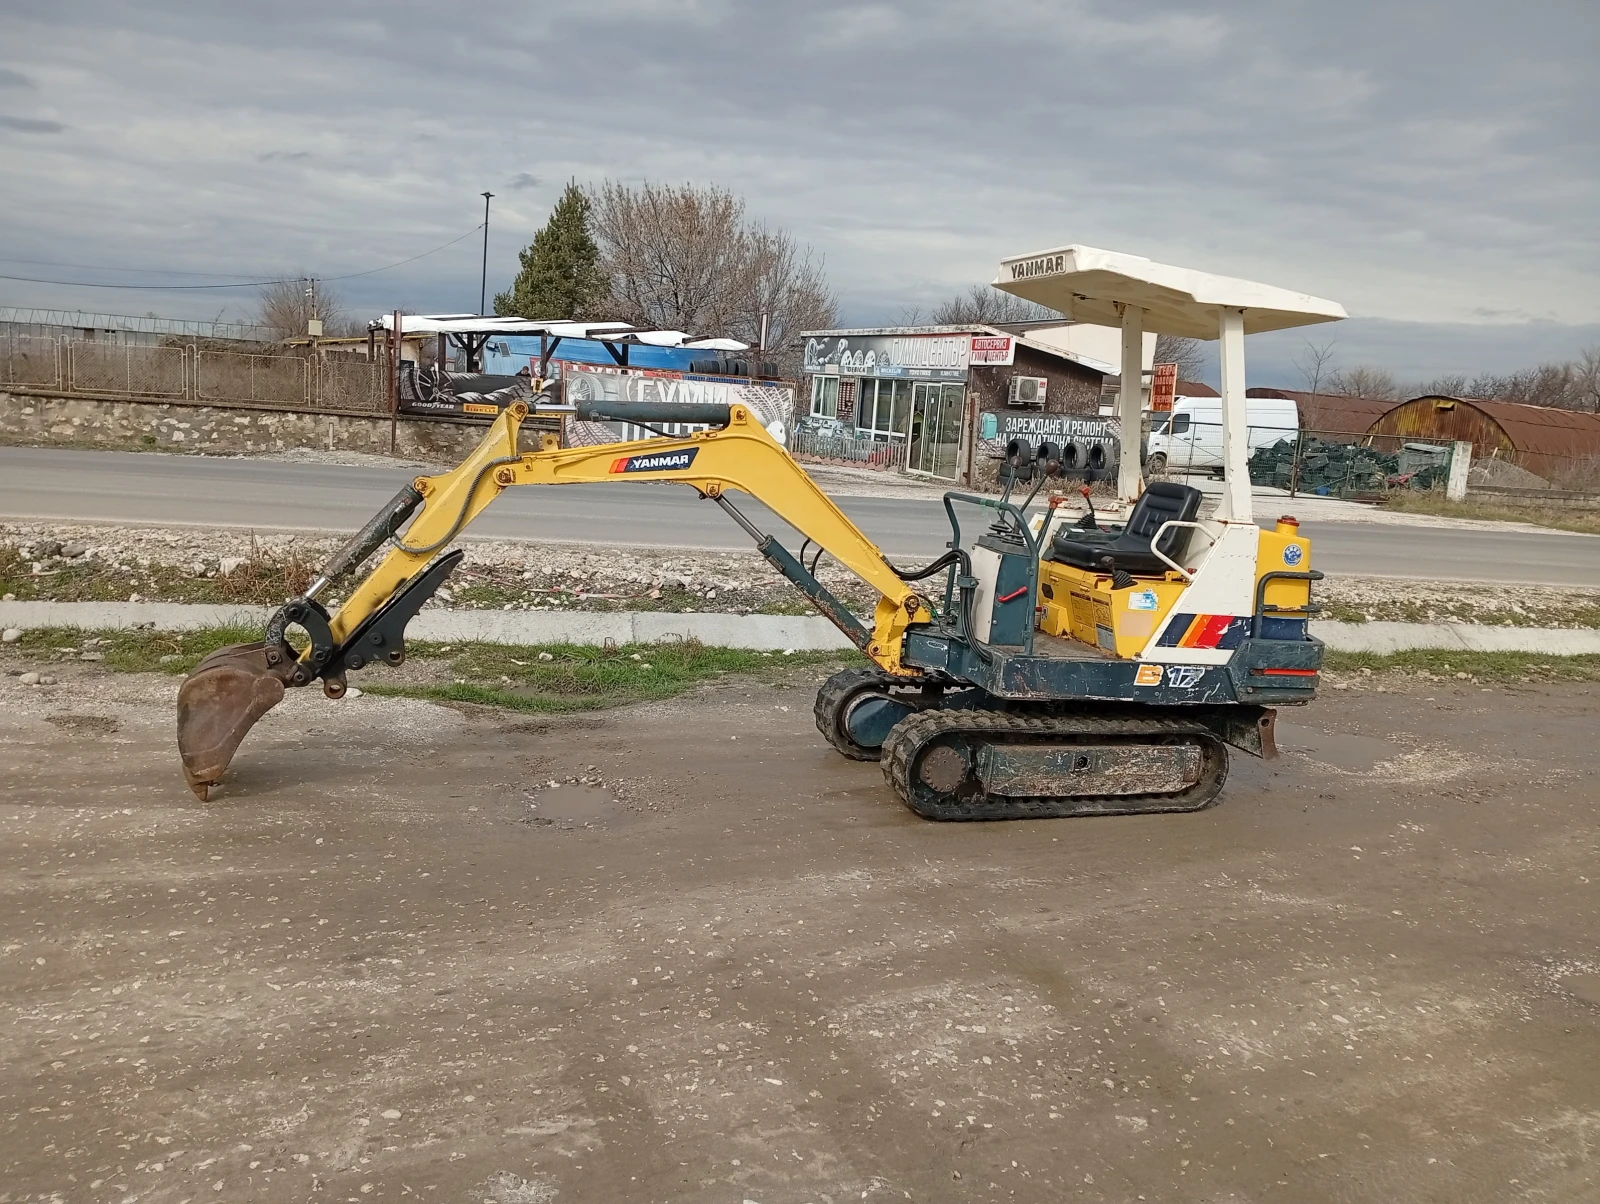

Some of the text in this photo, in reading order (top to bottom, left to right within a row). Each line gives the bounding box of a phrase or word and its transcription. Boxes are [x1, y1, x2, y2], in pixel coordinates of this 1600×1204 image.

[1011, 255, 1064, 279] YANMAR
[974, 339, 1007, 349] АВТОСЕРВИЗ
[891, 337, 967, 367] ГУМИ ЦЕНТЪР
[971, 351, 1009, 362] ГУМИ ЦЕНТЪР
[637, 379, 728, 404] ГУМИ
[411, 402, 455, 410] GOODYEAR
[465, 404, 497, 413] PIRELLI
[1005, 417, 1108, 437] ЗАРЕЖДАНЕ И РЕМОНТ
[995, 433, 1007, 447] НА
[632, 454, 689, 468] YANMAR
